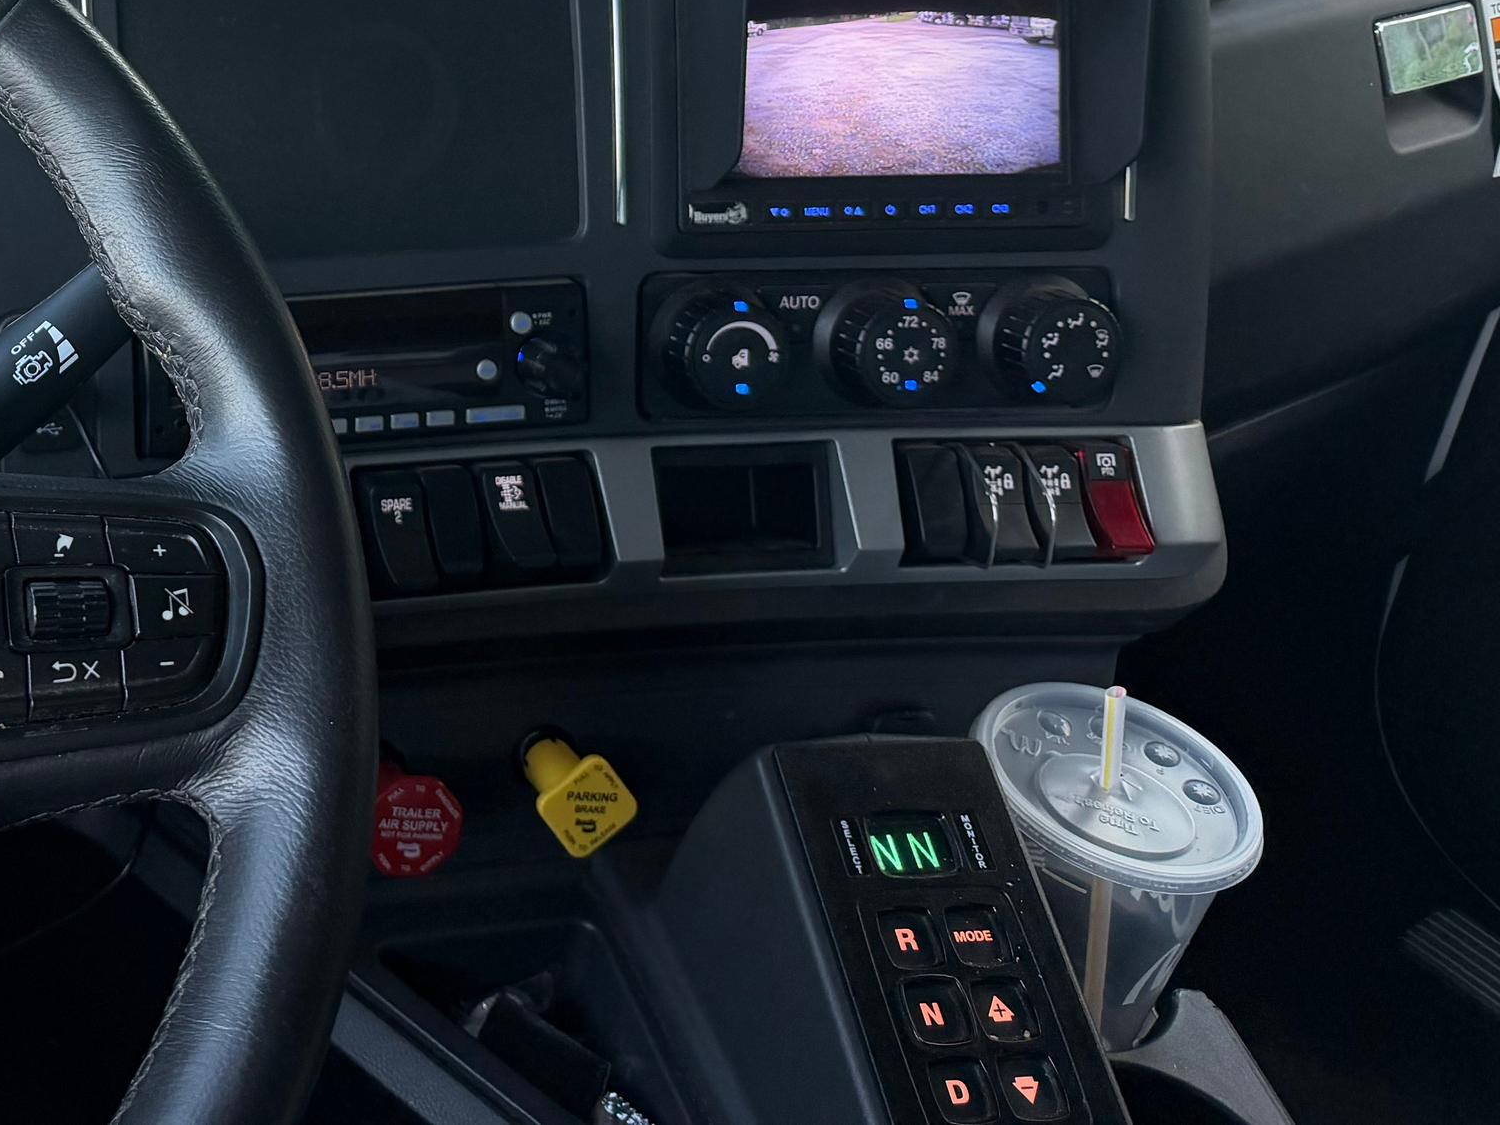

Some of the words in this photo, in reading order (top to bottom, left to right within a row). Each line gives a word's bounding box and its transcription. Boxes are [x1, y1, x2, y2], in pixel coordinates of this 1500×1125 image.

[803, 206, 830, 217] MENU
[779, 295, 820, 309] AUTO
[948, 305, 975, 316] MAX
[902, 316, 919, 328] 72
[10, 331, 37, 355] OFF
[875, 337, 894, 350] 66
[931, 337, 946, 349] 78
[881, 371, 899, 384] 60
[922, 370, 939, 382] 84
[380, 497, 412, 513] SPARE
[394, 510, 403, 524] 2
[566, 790, 619, 803] PARKING
[391, 806, 442, 819] TRAILER
[574, 804, 607, 815] BRAKE
[378, 818, 400, 830] AIR
[402, 820, 449, 833] SUPPLY
[1098, 812, 1140, 836] Time
[840, 819, 863, 875] SELECT
[959, 813, 988, 870] MONITOR
[894, 928, 920, 952] R
[953, 929, 994, 944] MODE
[918, 1001, 946, 1026] N
[944, 1079, 971, 1105] D
